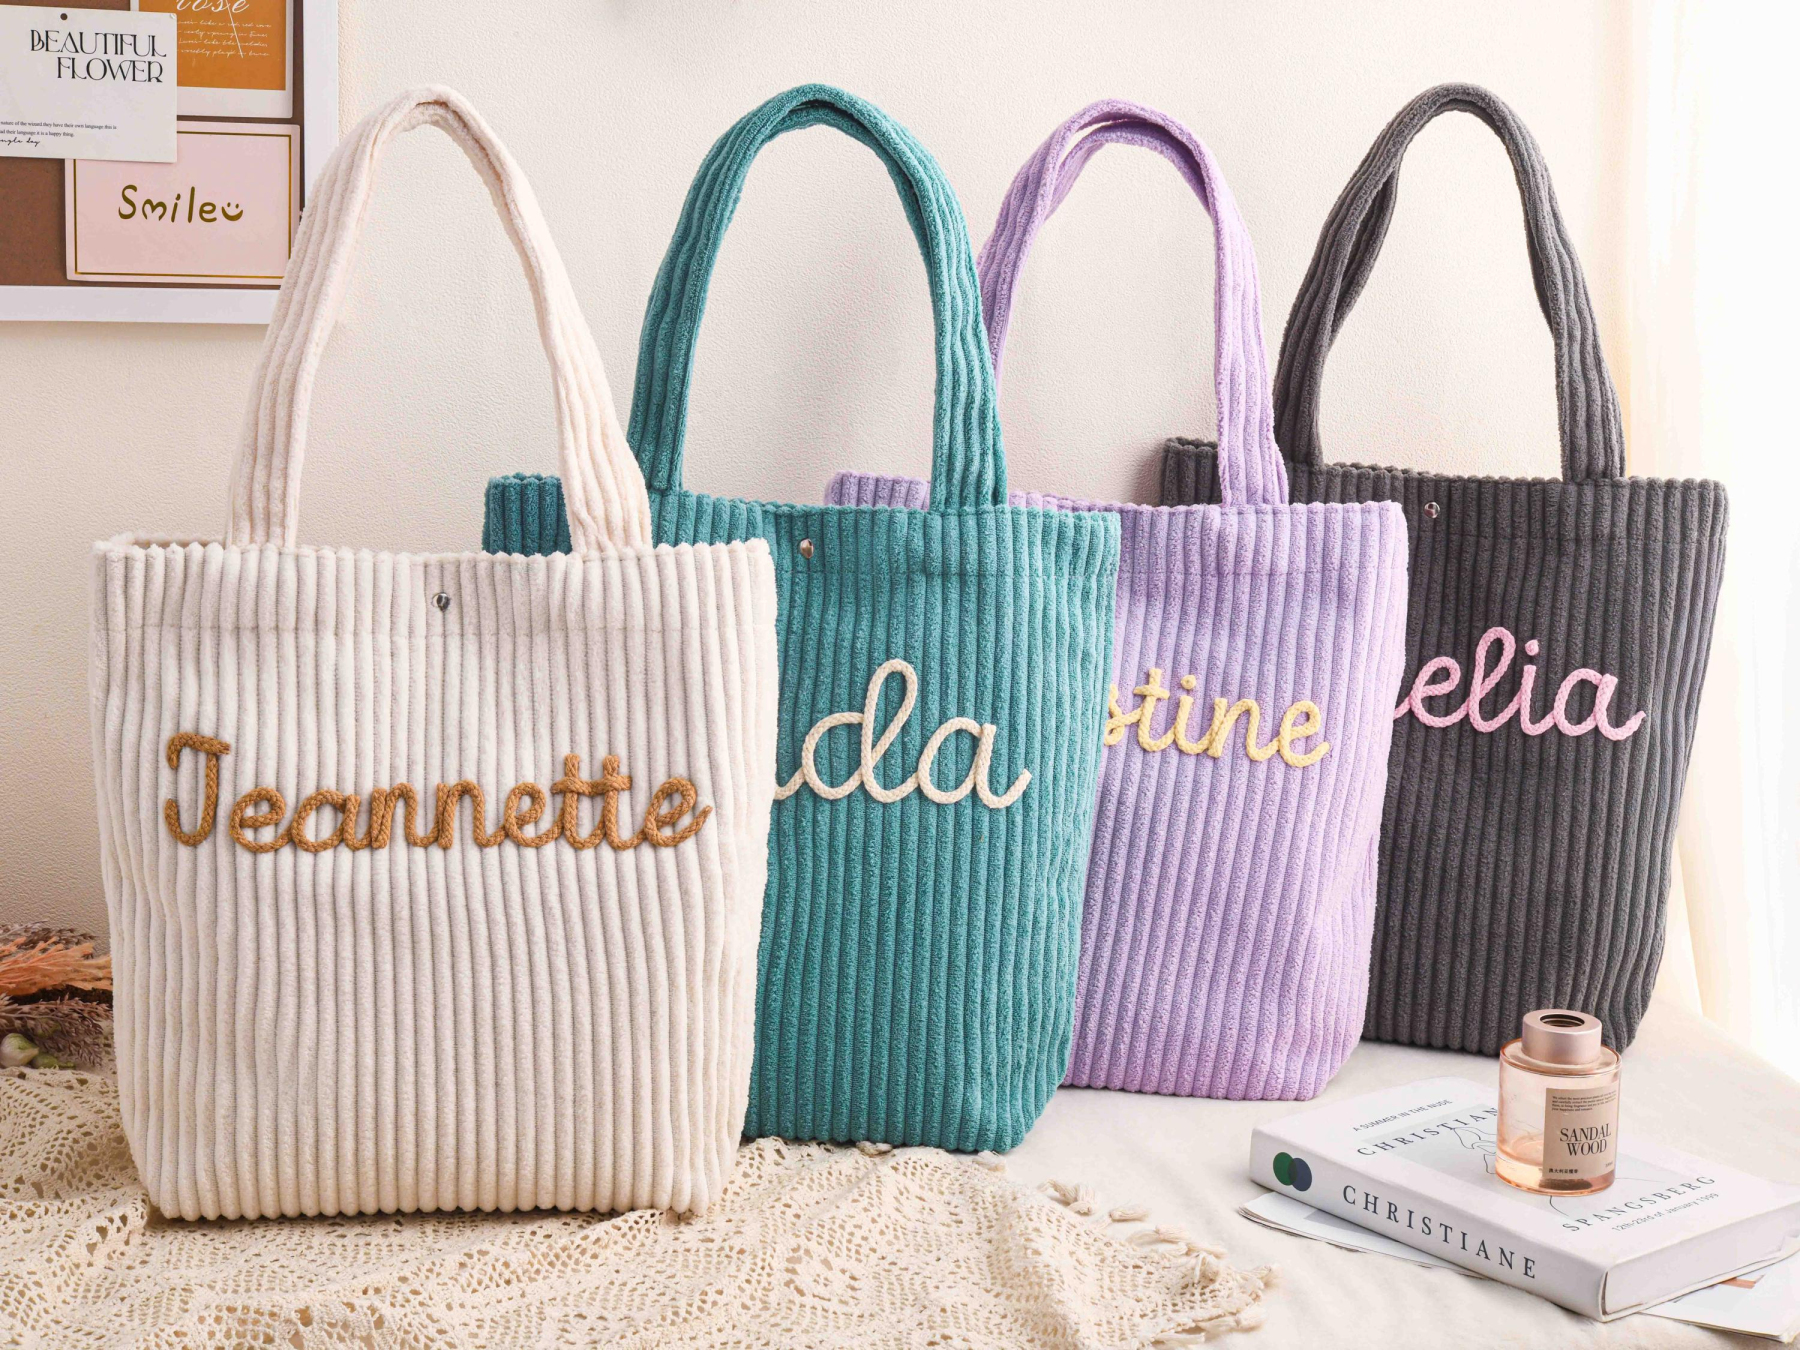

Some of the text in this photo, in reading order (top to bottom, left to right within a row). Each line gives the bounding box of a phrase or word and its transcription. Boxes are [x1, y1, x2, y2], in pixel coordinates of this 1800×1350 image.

[30, 29, 167, 58] BEAUTIFUL
[57, 56, 164, 83] FLOWER
[118, 184, 217, 223] Smile
[1393, 627, 1646, 740] elia
[774, 659, 1032, 808] da
[165, 731, 714, 854] Jeannette
[1408, 1106, 1429, 1114] THE
[1559, 1123, 1612, 1142] SANDAL
[1566, 1140, 1608, 1157] WOOD
[1562, 1175, 1715, 1232] SPANGSBERG
[1342, 1185, 1536, 1279] CHRISTIANE
